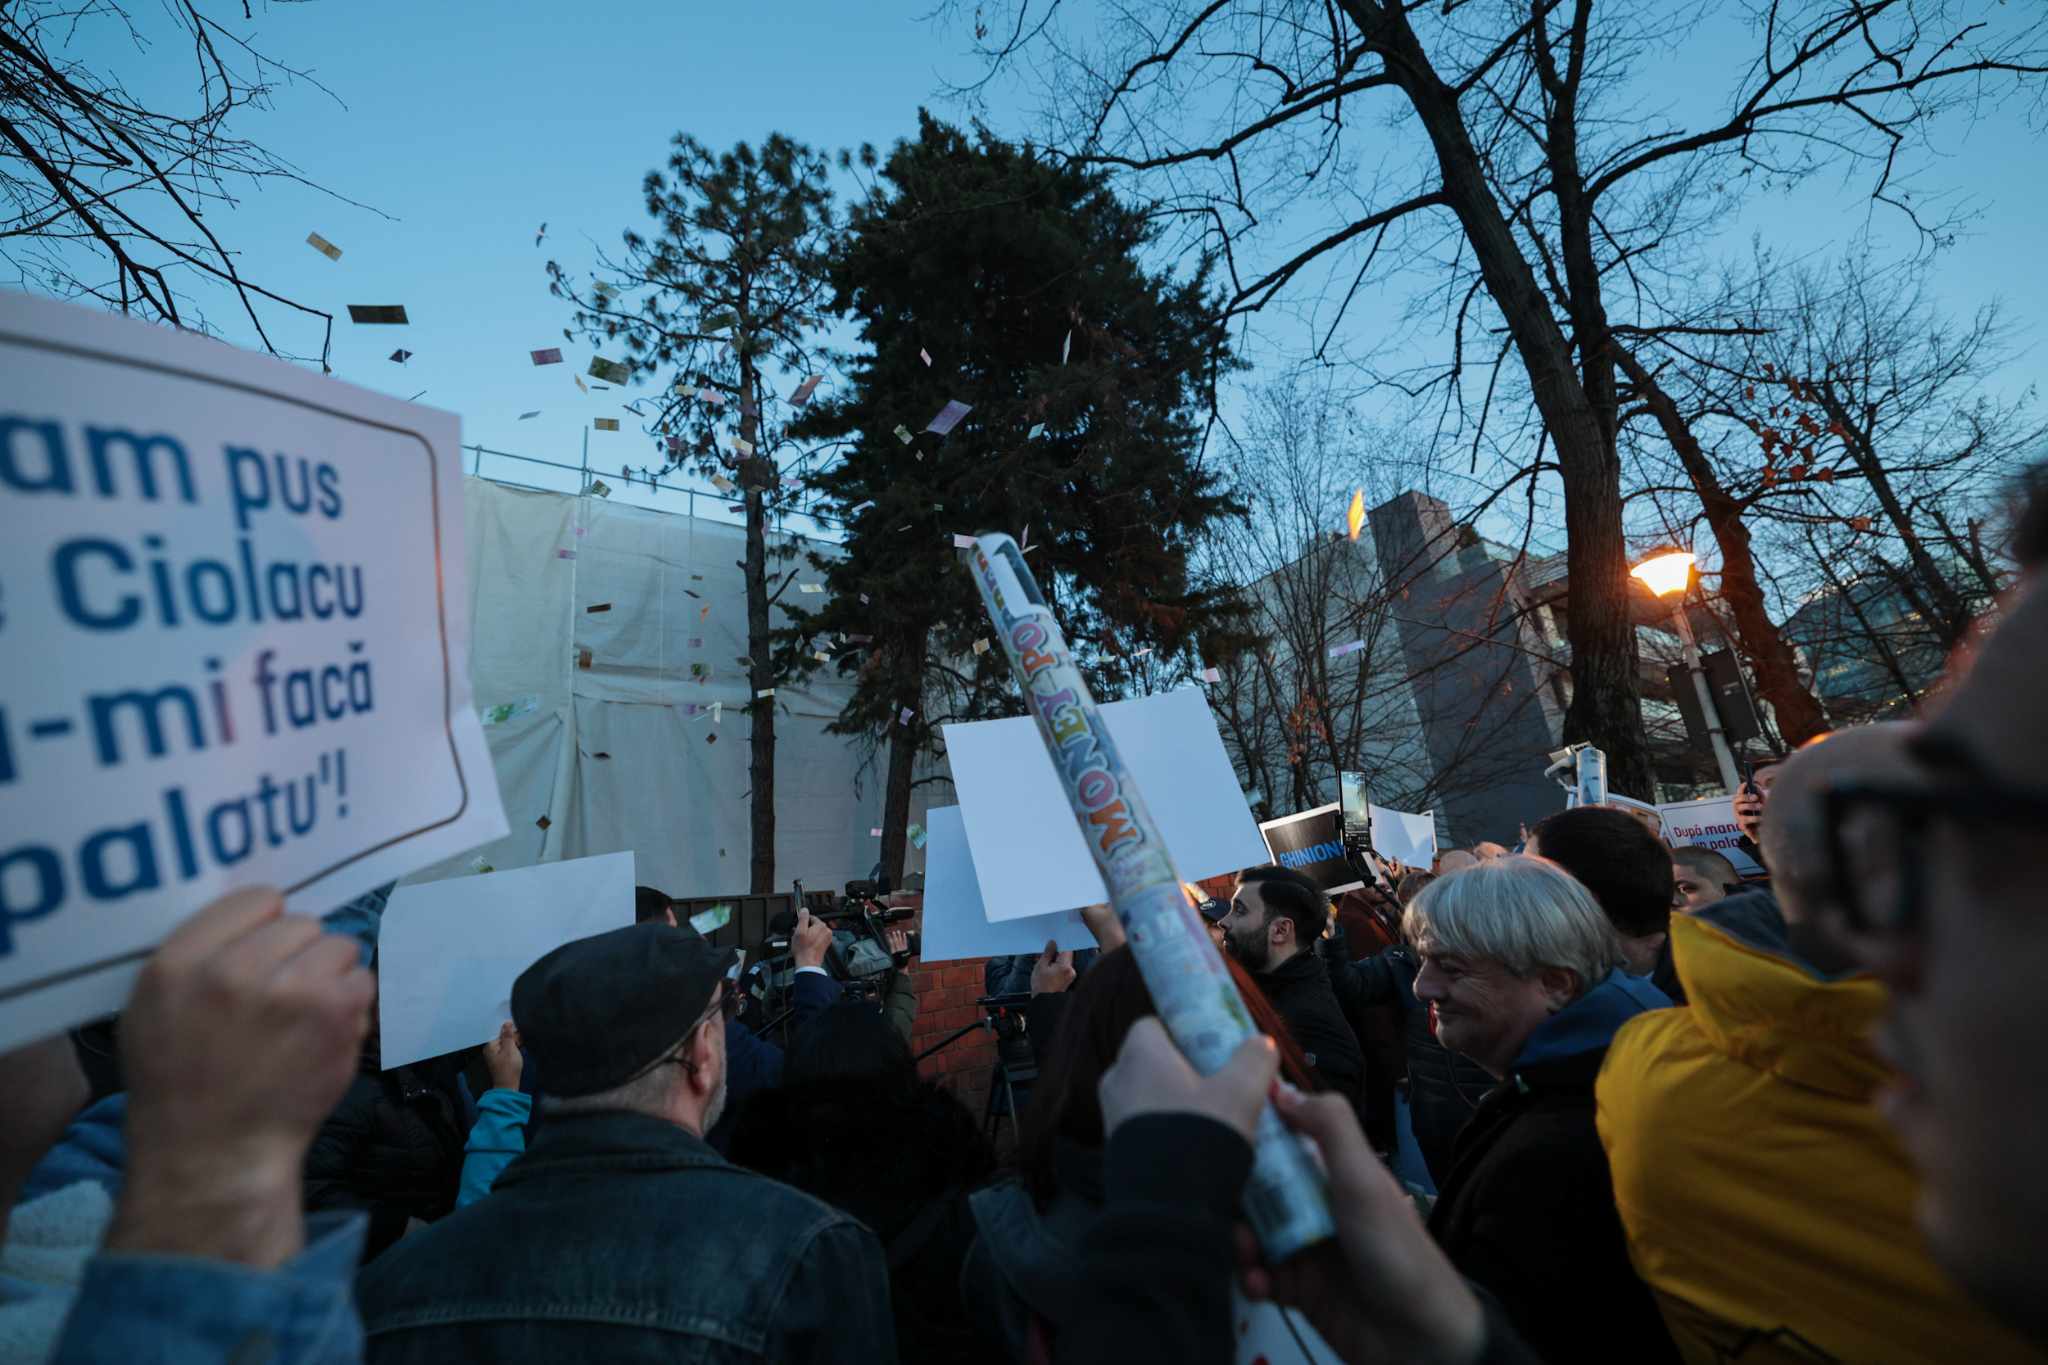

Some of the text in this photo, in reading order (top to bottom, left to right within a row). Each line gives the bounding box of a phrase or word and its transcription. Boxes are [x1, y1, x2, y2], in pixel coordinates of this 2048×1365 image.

[224, 442, 343, 530] pus
[49, 534, 365, 634] Ciolacu
[0, 643, 374, 788] -mi facă
[1036, 688, 1140, 855] MONEY
[1673, 823, 1740, 839] După man
